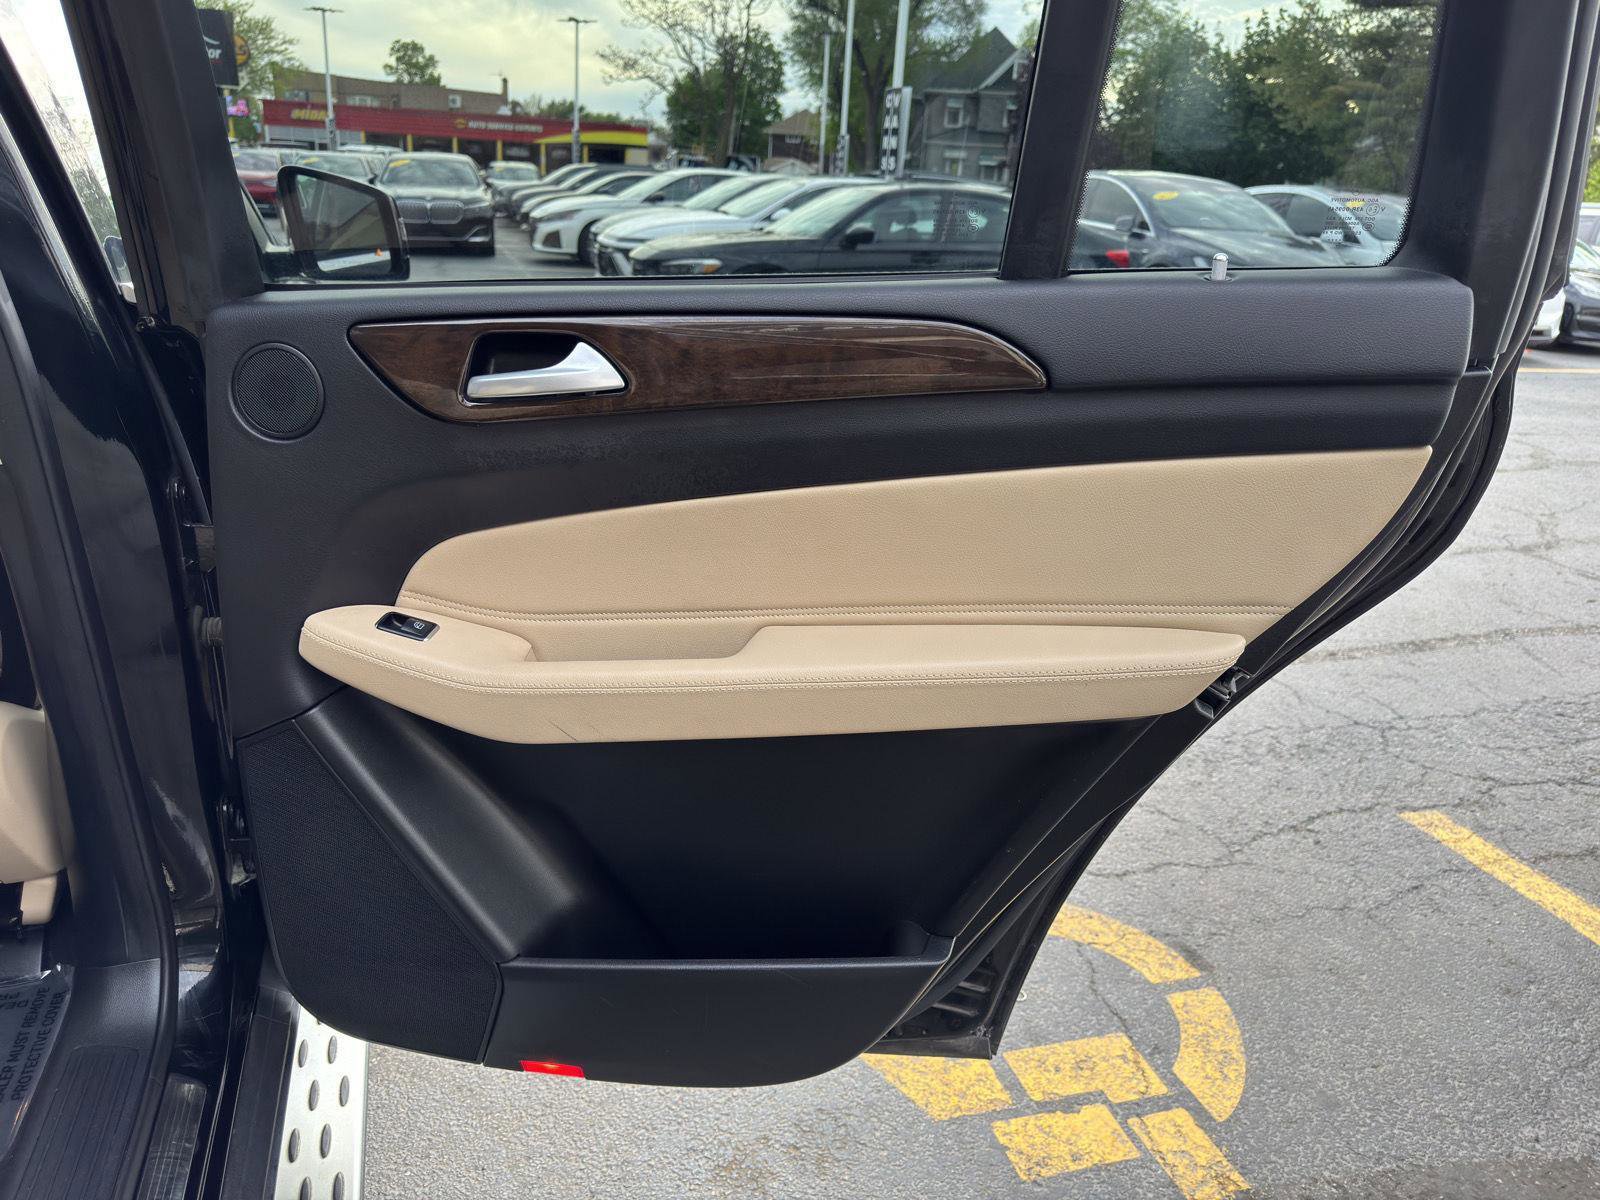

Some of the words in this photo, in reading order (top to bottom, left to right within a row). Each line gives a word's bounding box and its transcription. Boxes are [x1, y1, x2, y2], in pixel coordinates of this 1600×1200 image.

[7, 1031, 31, 1062] MUST
[21, 987, 50, 1028] REMOVE
[11, 1029, 51, 1101] PROTECTIVE
[44, 988, 67, 1028] COVER
